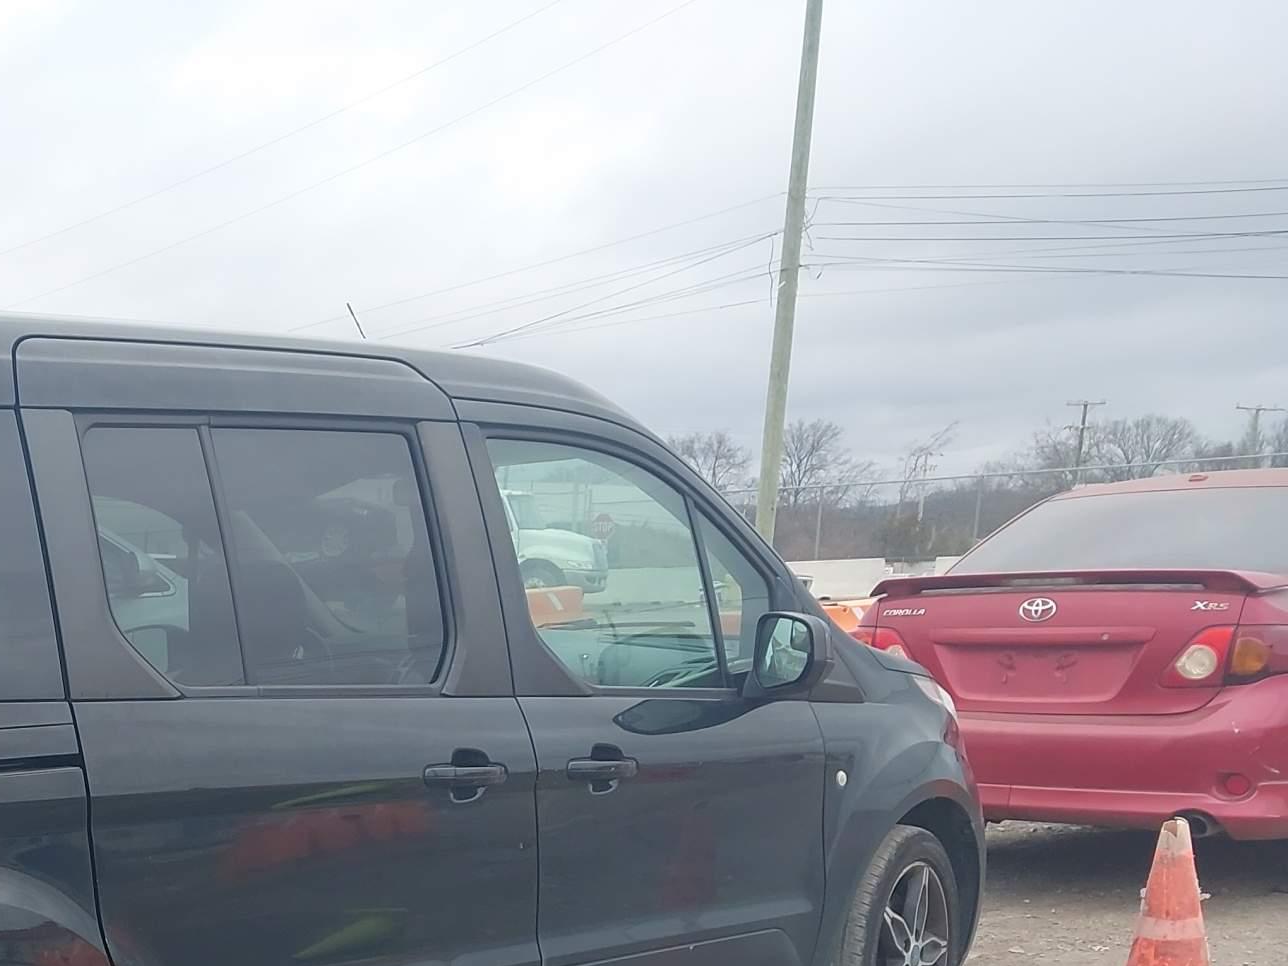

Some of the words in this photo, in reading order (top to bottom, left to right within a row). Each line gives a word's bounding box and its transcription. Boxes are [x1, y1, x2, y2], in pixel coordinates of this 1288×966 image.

[592, 521, 613, 532] STOP
[1190, 601, 1230, 610] XRS
[883, 608, 926, 616] COROLLA
